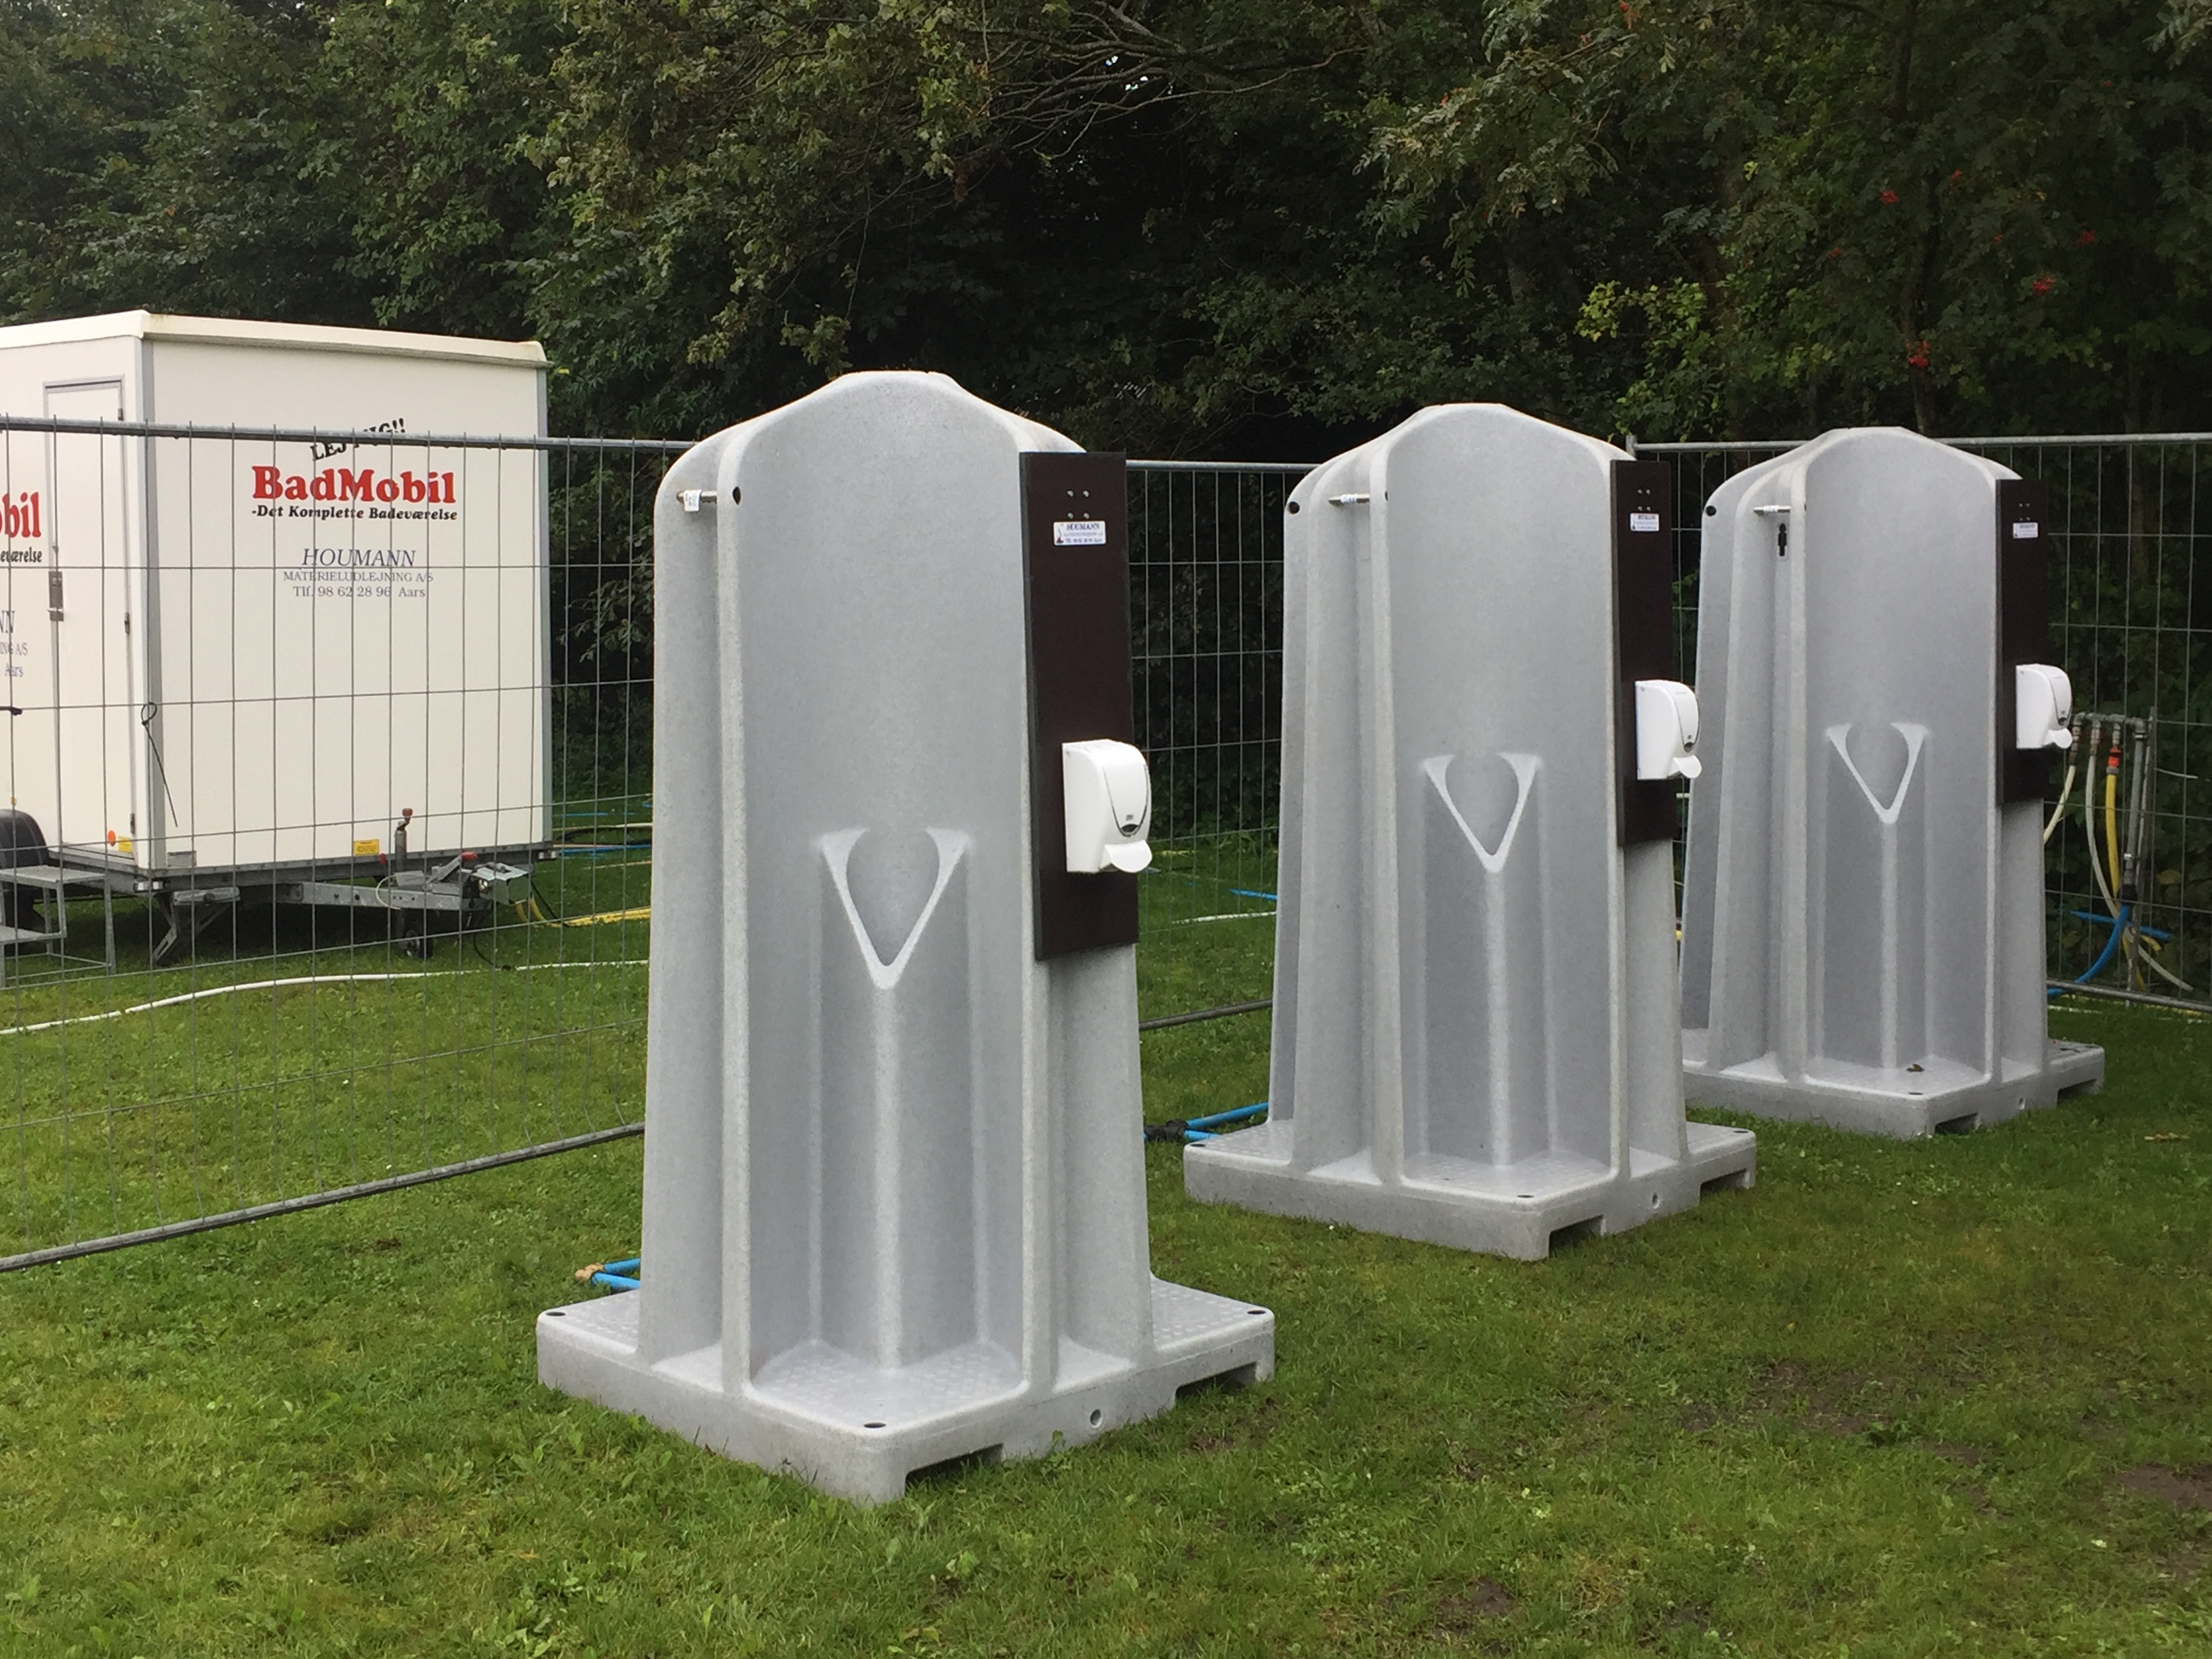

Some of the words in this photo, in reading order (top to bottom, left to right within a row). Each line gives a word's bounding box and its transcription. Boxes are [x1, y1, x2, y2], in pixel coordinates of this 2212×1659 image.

[251, 466, 456, 504] BadMobil
[0, 492, 41, 537] bil
[289, 506, 364, 520] Komplette
[369, 507, 457, 520] Badeværelse
[302, 548, 416, 567] HOUMANN
[283, 571, 412, 581] MATERIELUDLEJNING
[415, 572, 434, 582] A/S
[318, 586, 333, 596] 98
[337, 586, 353, 596] 62
[357, 586, 372, 596] 28
[376, 586, 391, 596] 96
[398, 587, 426, 597] Aars
